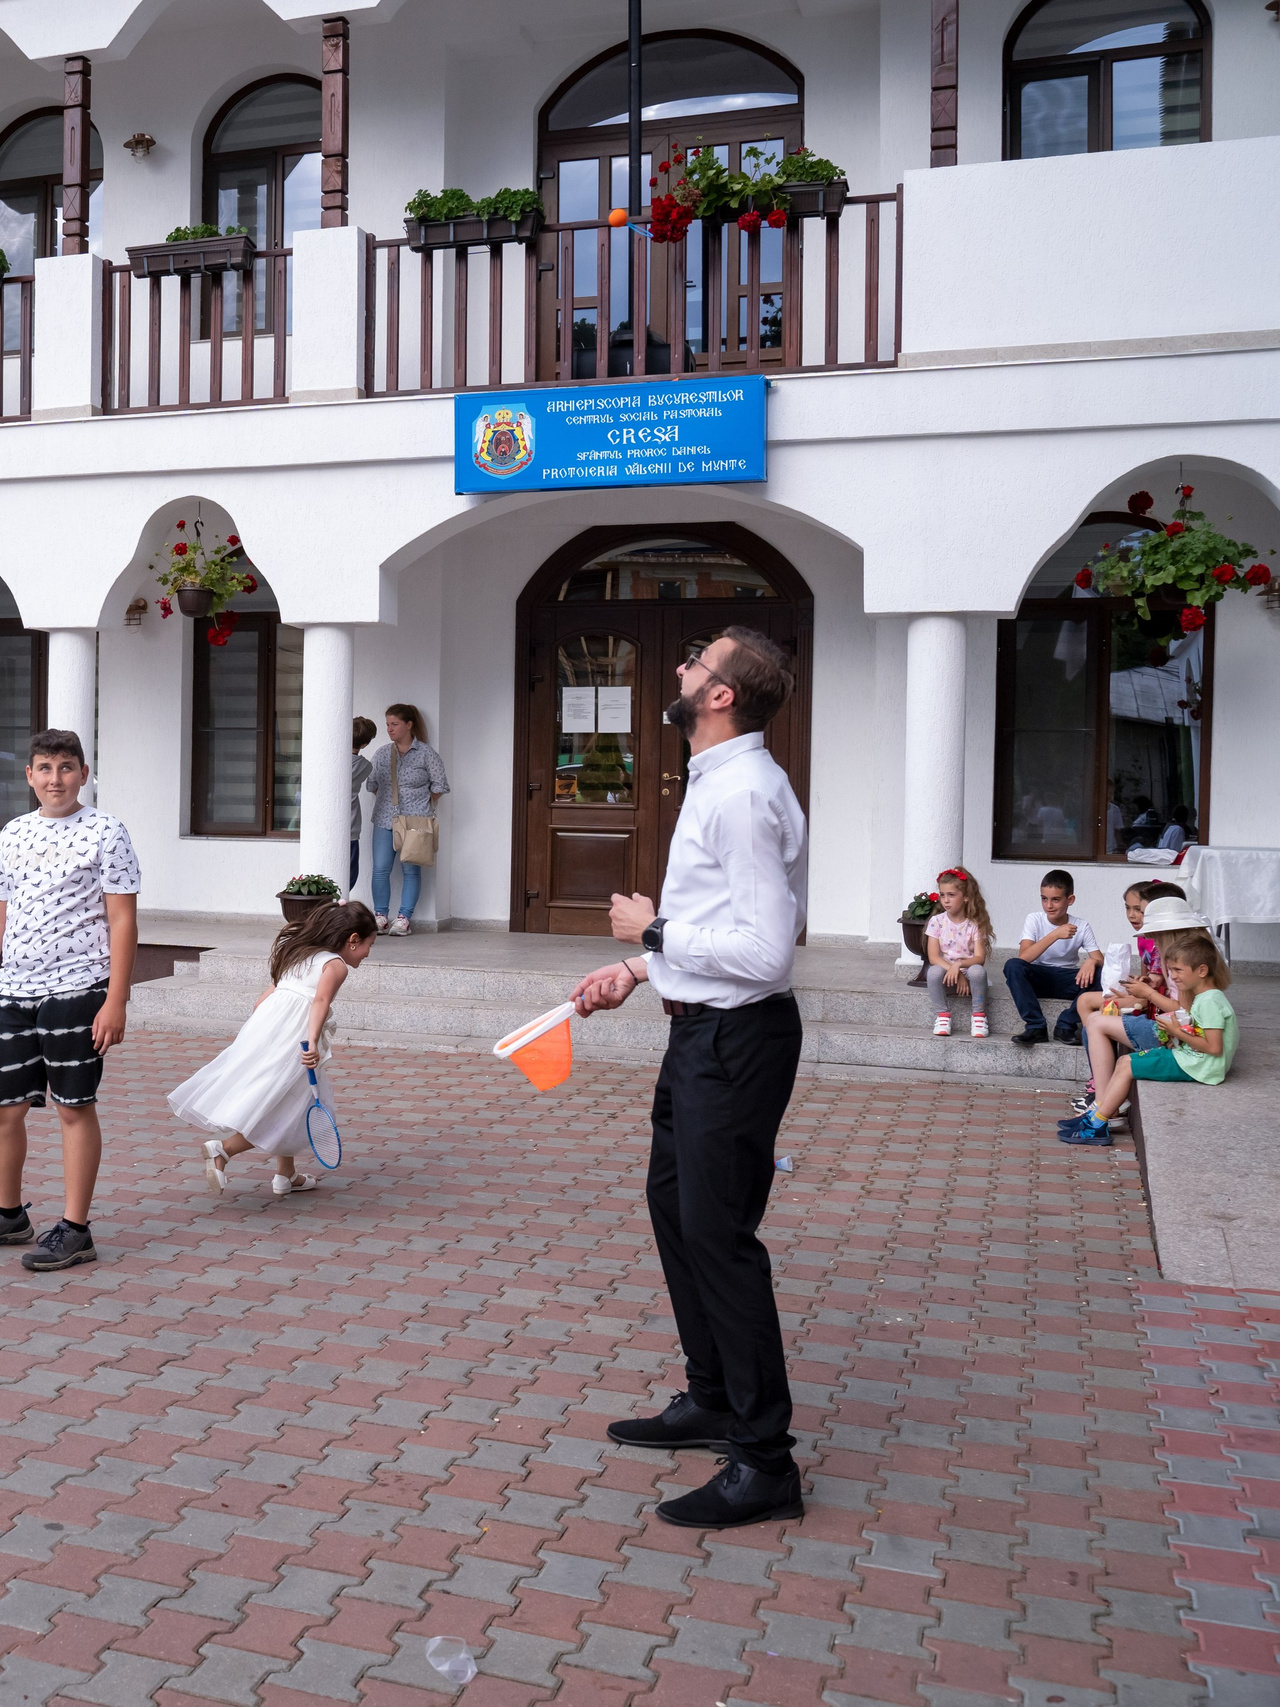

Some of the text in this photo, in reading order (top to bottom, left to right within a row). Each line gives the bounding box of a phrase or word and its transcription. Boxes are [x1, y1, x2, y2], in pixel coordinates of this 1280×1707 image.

[546, 396, 641, 413] ARHIEPISCOPIA
[565, 407, 723, 426] CENTRUL SOCIAL PASTORAL
[607, 425, 680, 446] CREȘA
[576, 445, 711, 461] SFÂNTUL PROROC DANIEL
[542, 459, 747, 479] PROTOIERIA VĂLENII DE MUNTE
